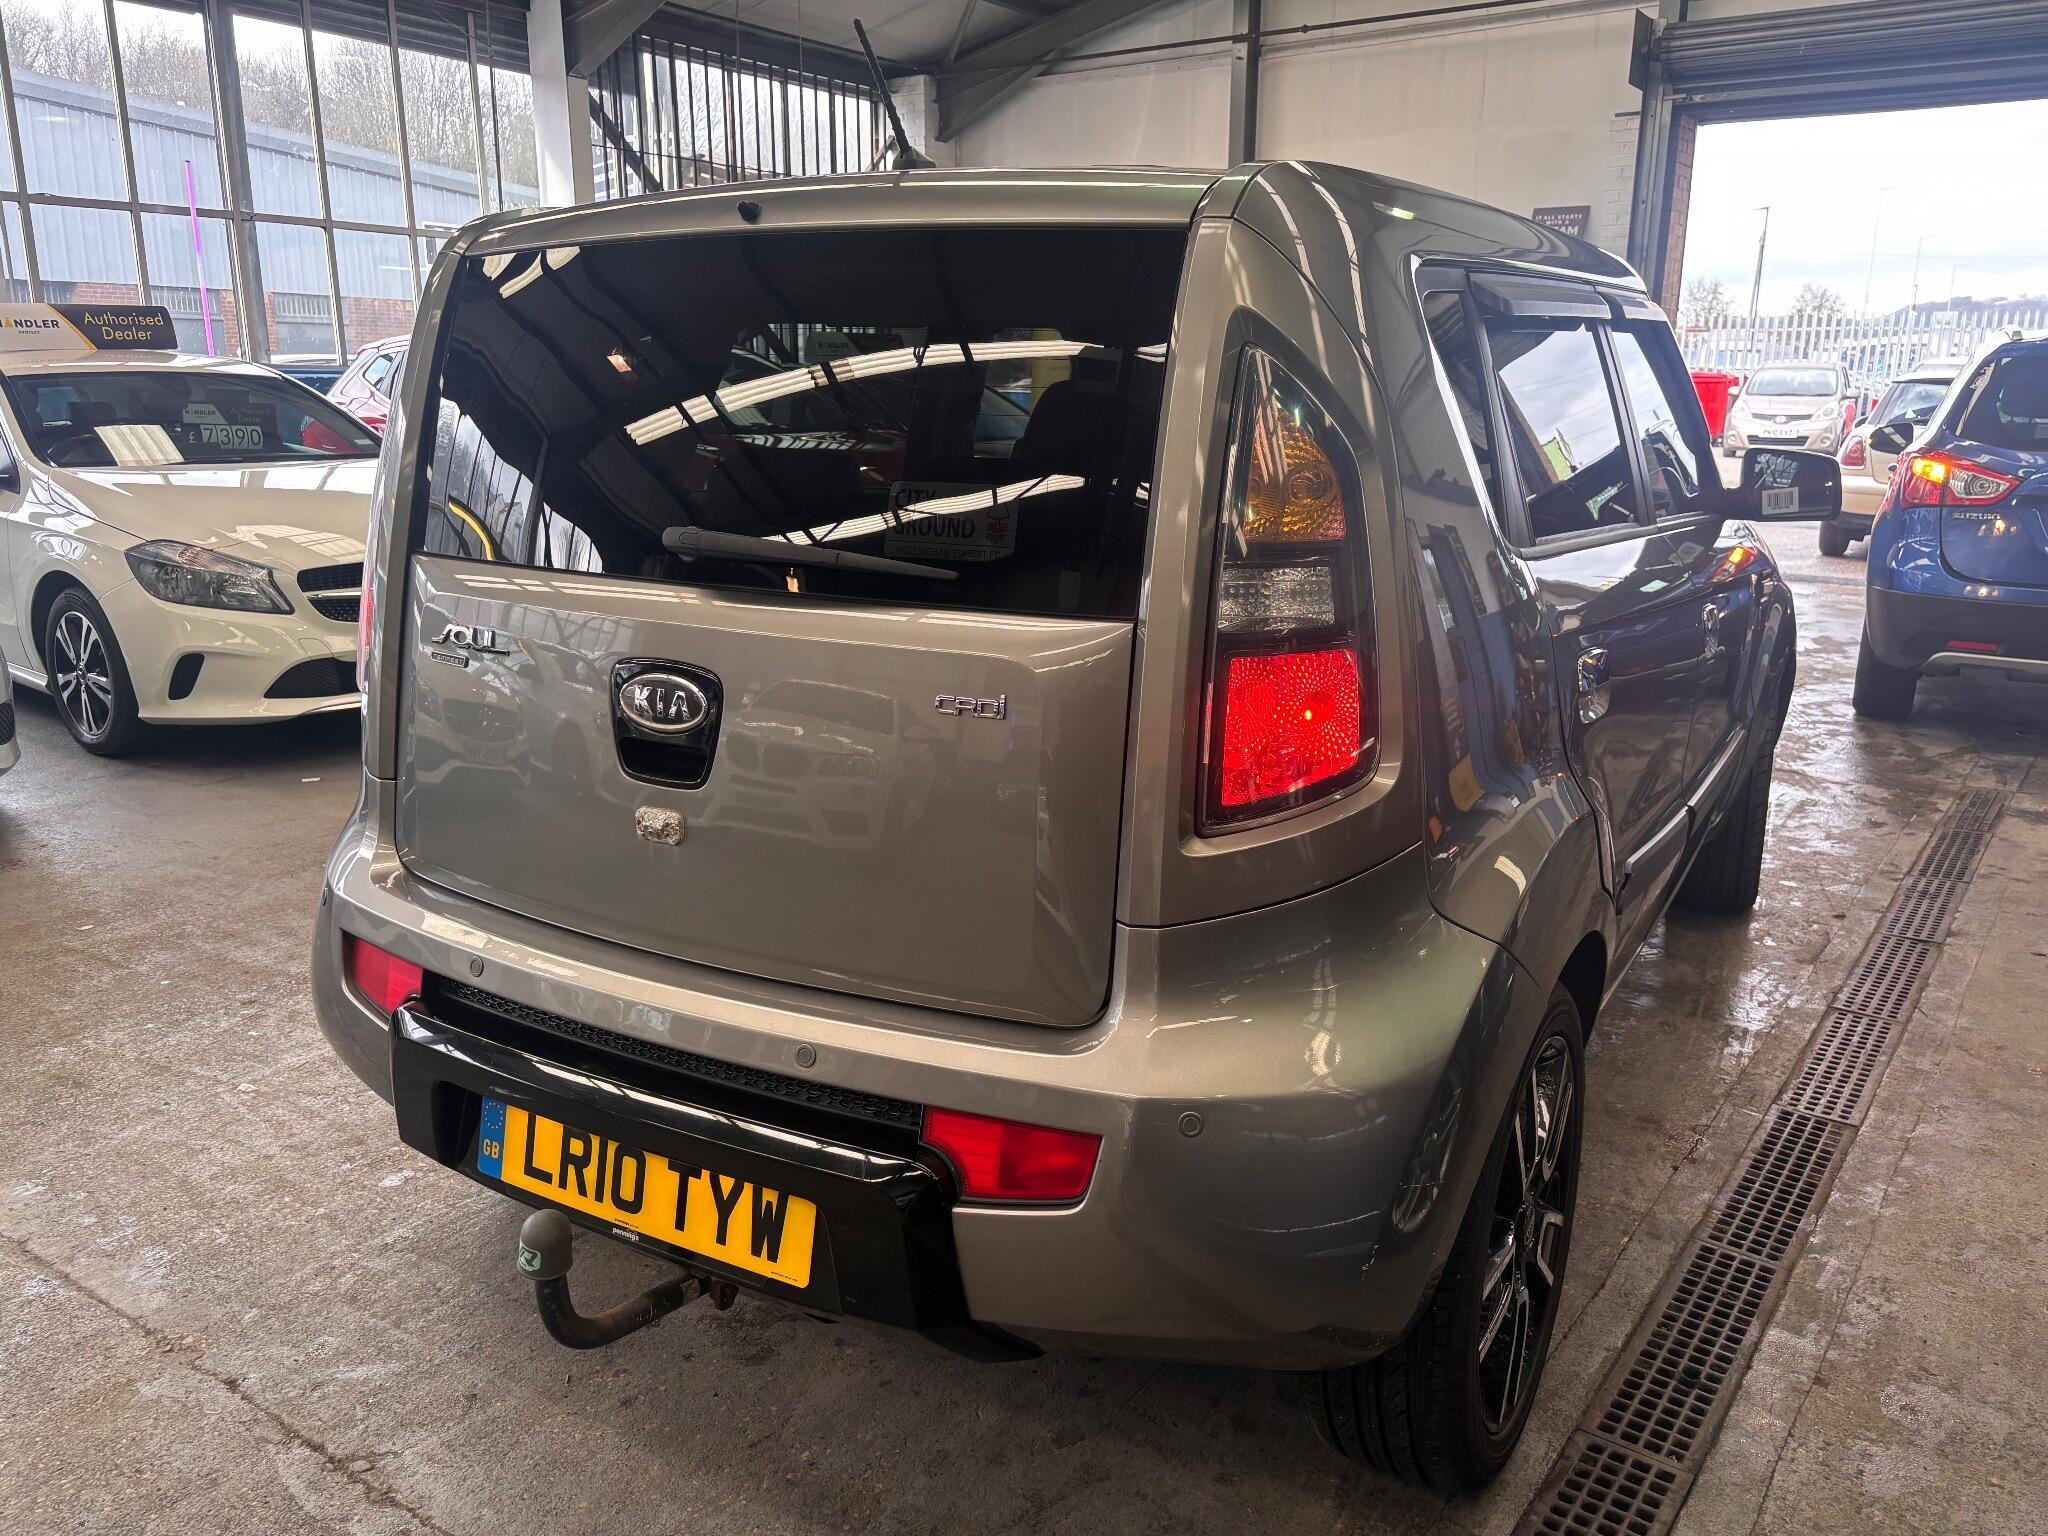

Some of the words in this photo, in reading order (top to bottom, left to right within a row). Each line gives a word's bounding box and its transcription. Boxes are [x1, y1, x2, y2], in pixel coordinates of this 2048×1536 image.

[84, 311, 164, 326] Authorised
[102, 326, 153, 341] Dealer
[633, 685, 692, 721] KIA
[483, 1138, 500, 1159] GB
[523, 1111, 647, 1215] LR10
[667, 1158, 791, 1265] TYW
